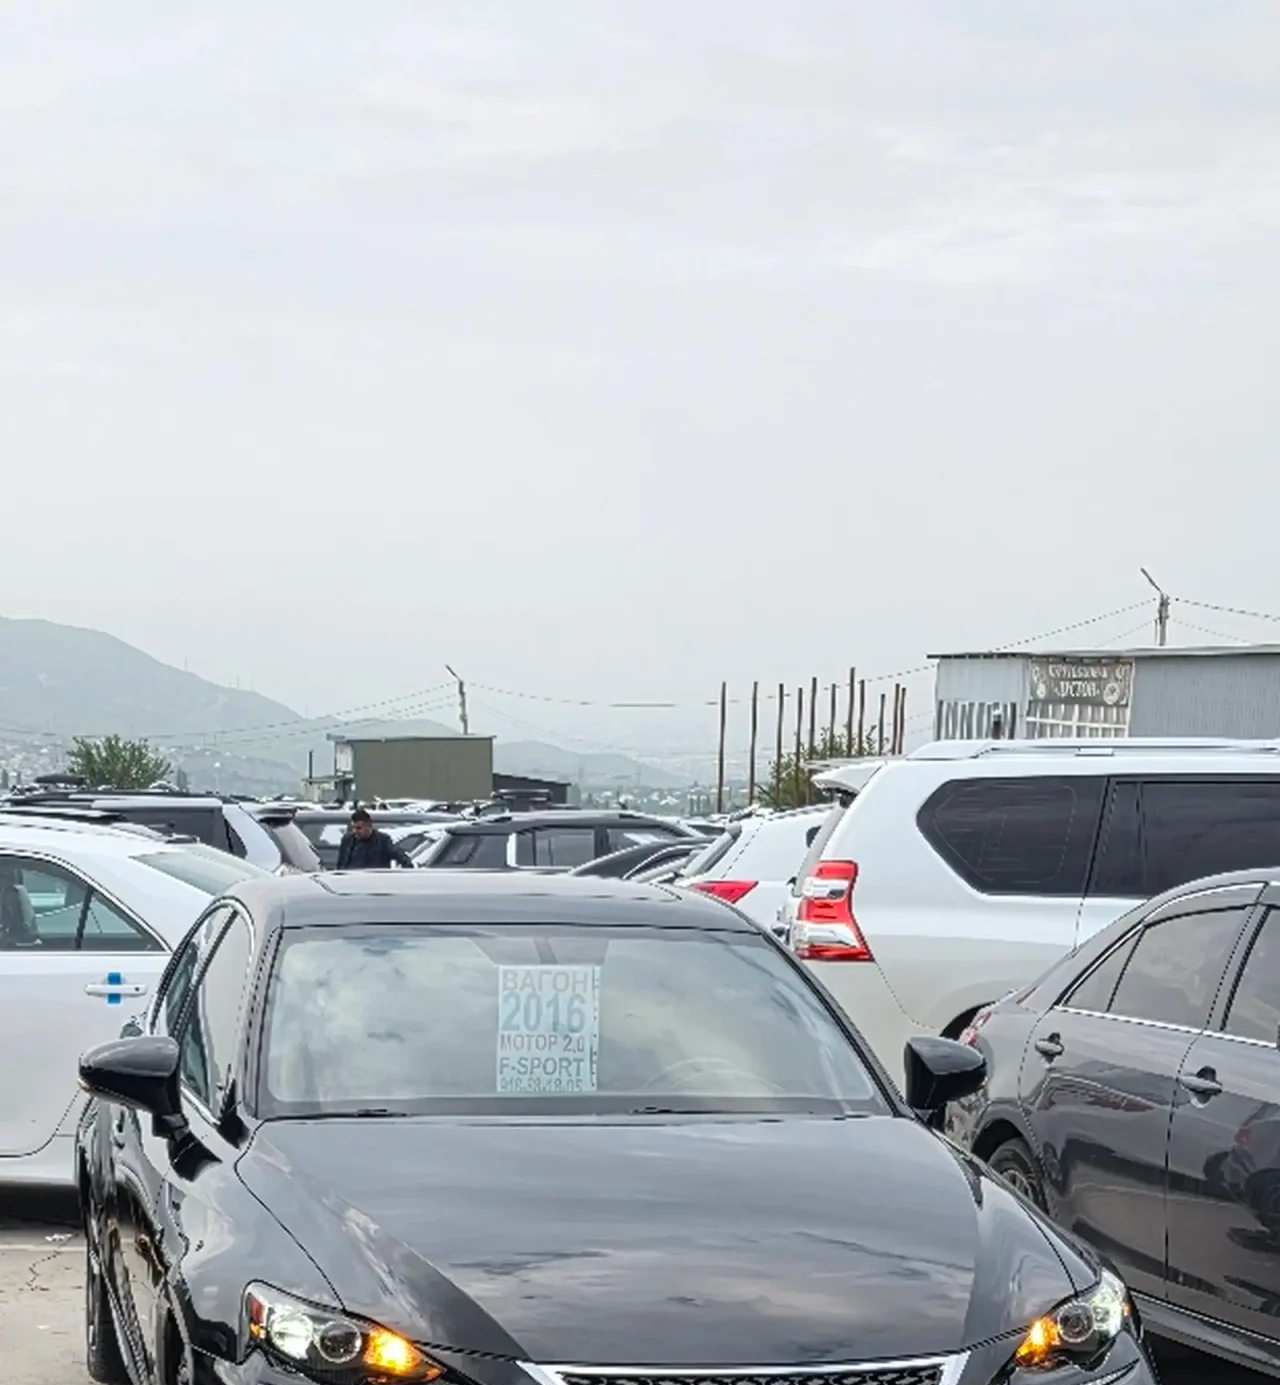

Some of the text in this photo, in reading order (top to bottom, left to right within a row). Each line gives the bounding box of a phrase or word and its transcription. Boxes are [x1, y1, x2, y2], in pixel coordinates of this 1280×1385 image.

[502, 970, 588, 993] ВАГОН
[500, 991, 586, 1033] 2016
[499, 1034, 558, 1051] МОТОР
[498, 1057, 585, 1077] F-SPORT
